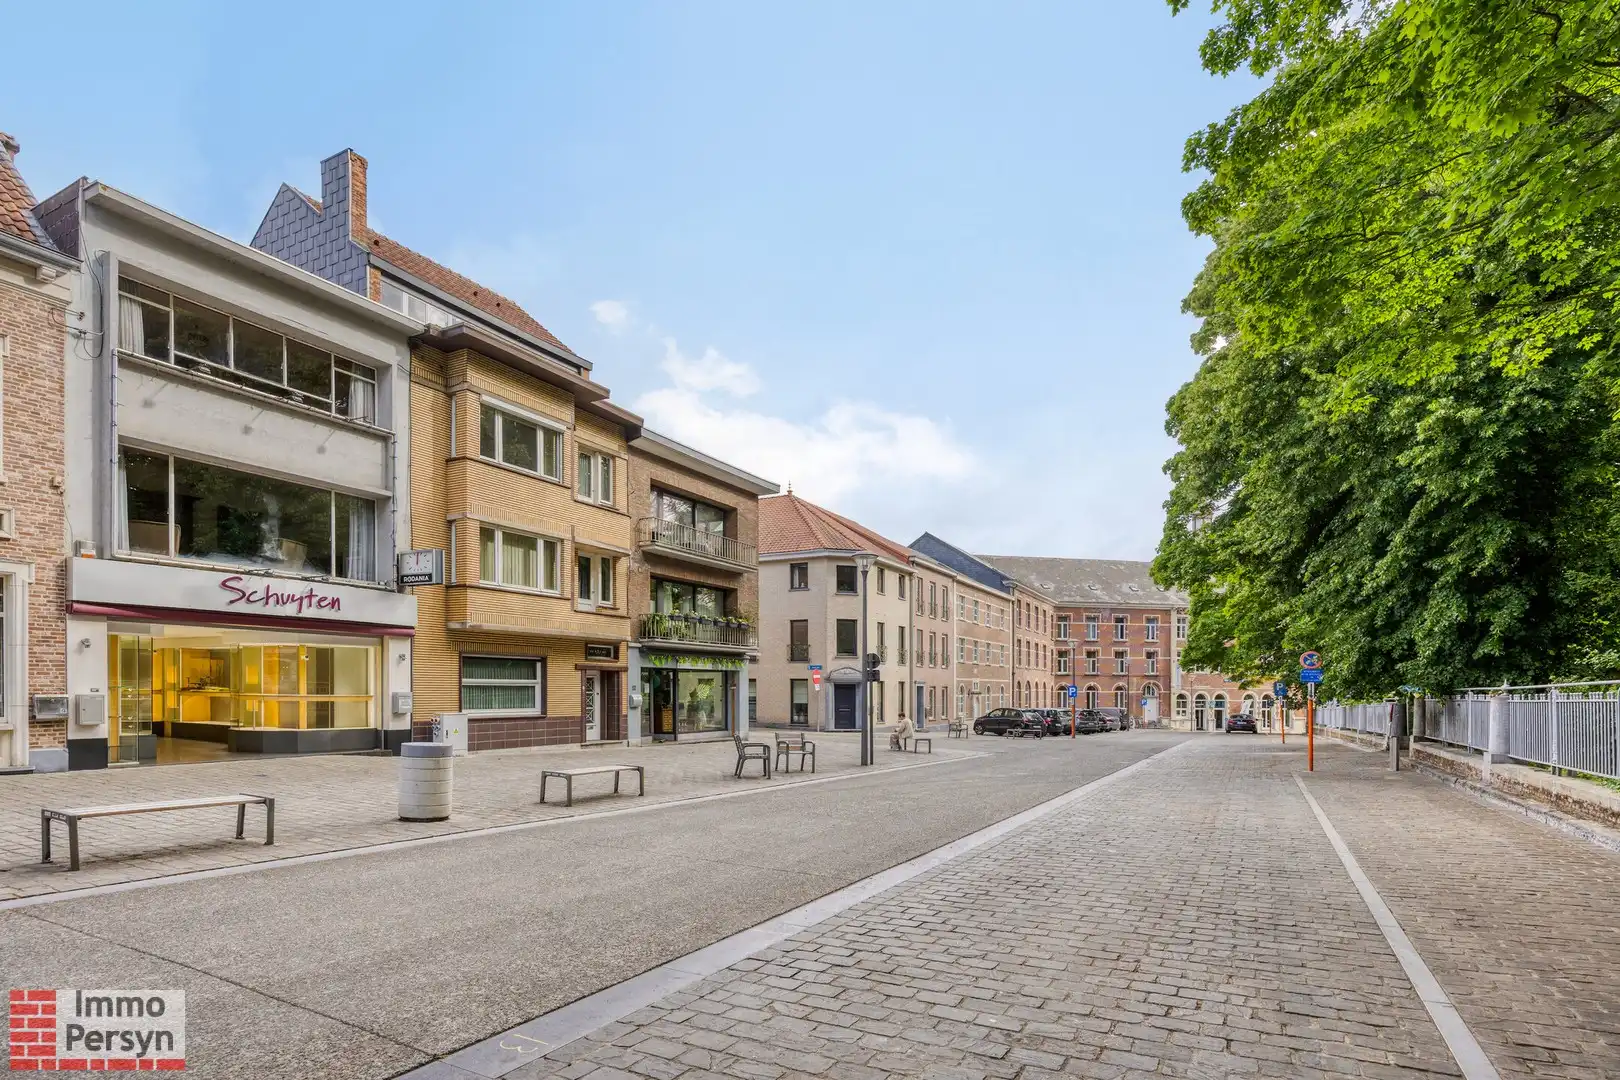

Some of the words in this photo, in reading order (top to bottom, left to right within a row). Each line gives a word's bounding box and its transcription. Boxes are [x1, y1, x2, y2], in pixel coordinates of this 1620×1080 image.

[403, 575, 430, 583] RODANIA
[219, 576, 342, 614] Schuyten
[1276, 682, 1284, 691] P
[1069, 687, 1076, 697] P
